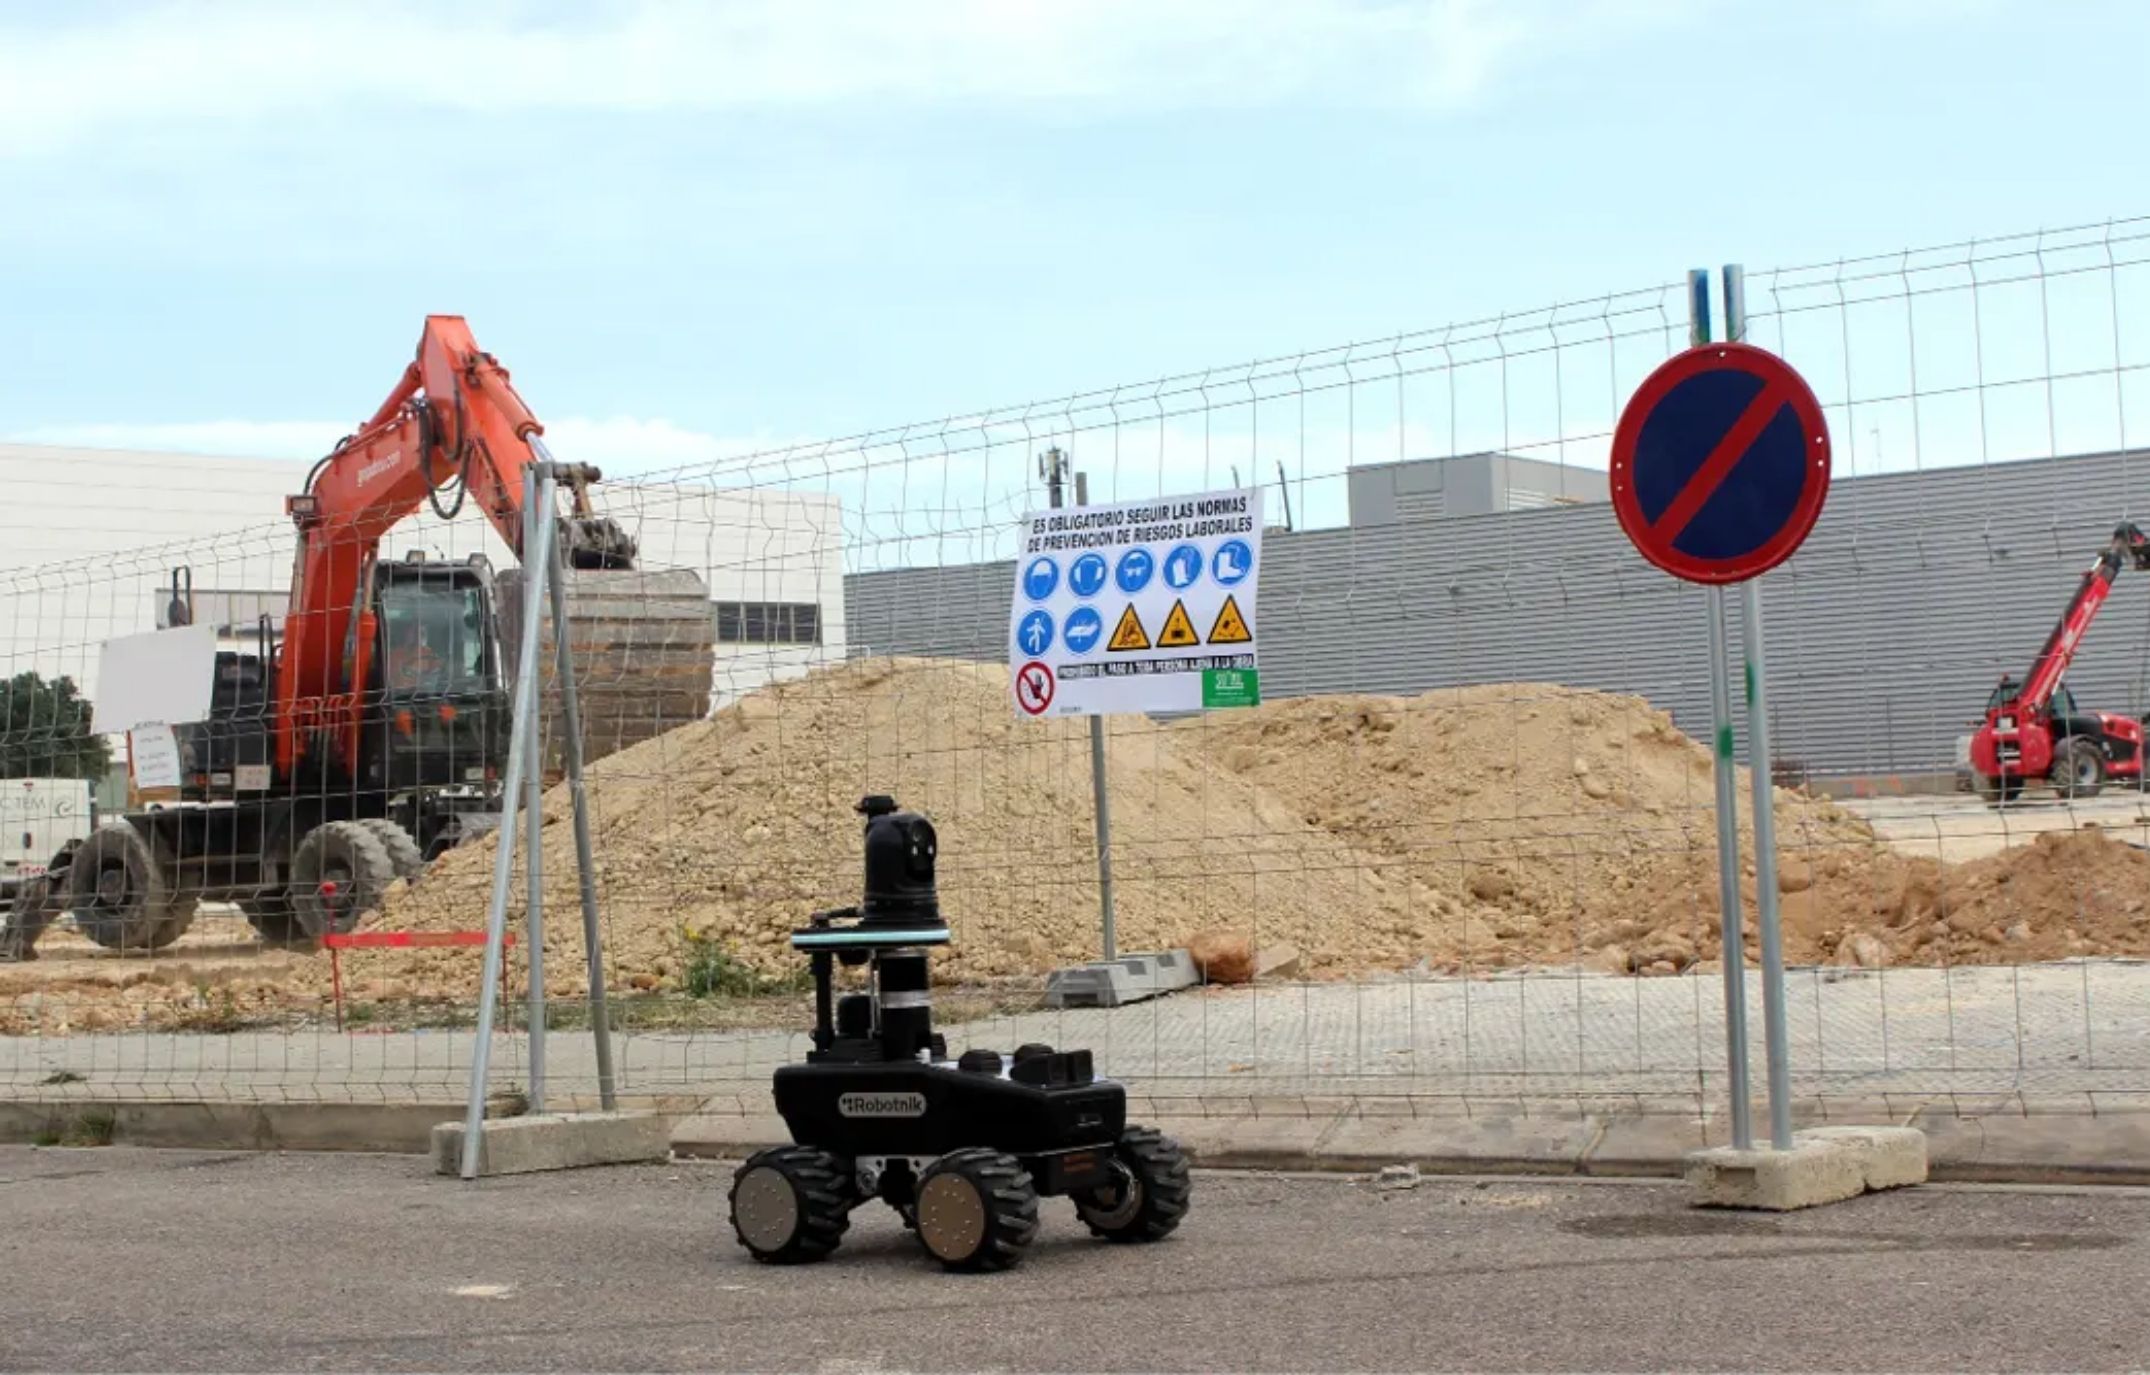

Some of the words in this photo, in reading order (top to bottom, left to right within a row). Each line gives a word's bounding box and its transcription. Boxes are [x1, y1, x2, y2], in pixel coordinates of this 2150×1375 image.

[1027, 538, 1041, 553] DE
[1116, 528, 1131, 544] DE
[1133, 523, 1184, 542] RIESGOS
[1185, 515, 1253, 538] LABORALES
[1033, 518, 1046, 534] ES
[1048, 509, 1124, 532] OBLIGATORIO
[1127, 504, 1169, 525] SEGUIR
[1173, 502, 1194, 520] LAS
[1197, 496, 1247, 517] NORMAS
[855, 1095, 922, 1113] Robotnik
